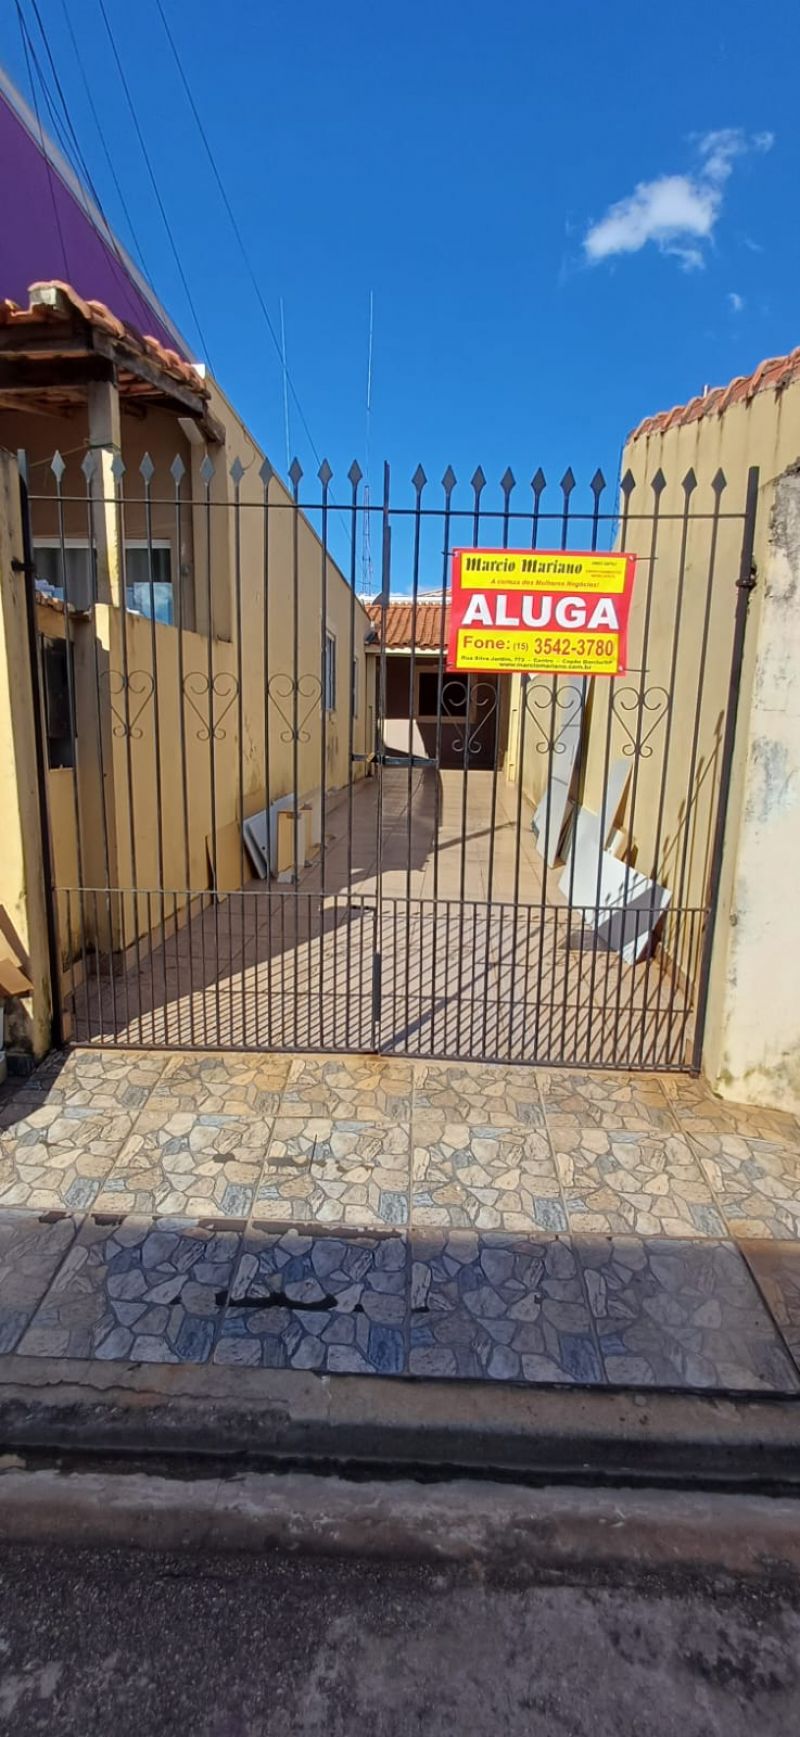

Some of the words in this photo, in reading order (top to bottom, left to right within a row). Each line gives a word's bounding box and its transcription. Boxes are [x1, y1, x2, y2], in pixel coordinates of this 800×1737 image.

[466, 557, 516, 572] Marcio
[521, 558, 583, 574] Mariano
[462, 594, 620, 630] ALUGA
[463, 635, 511, 650] Fone:
[513, 642, 529, 652] (15)
[534, 637, 614, 657] 3542-3780
